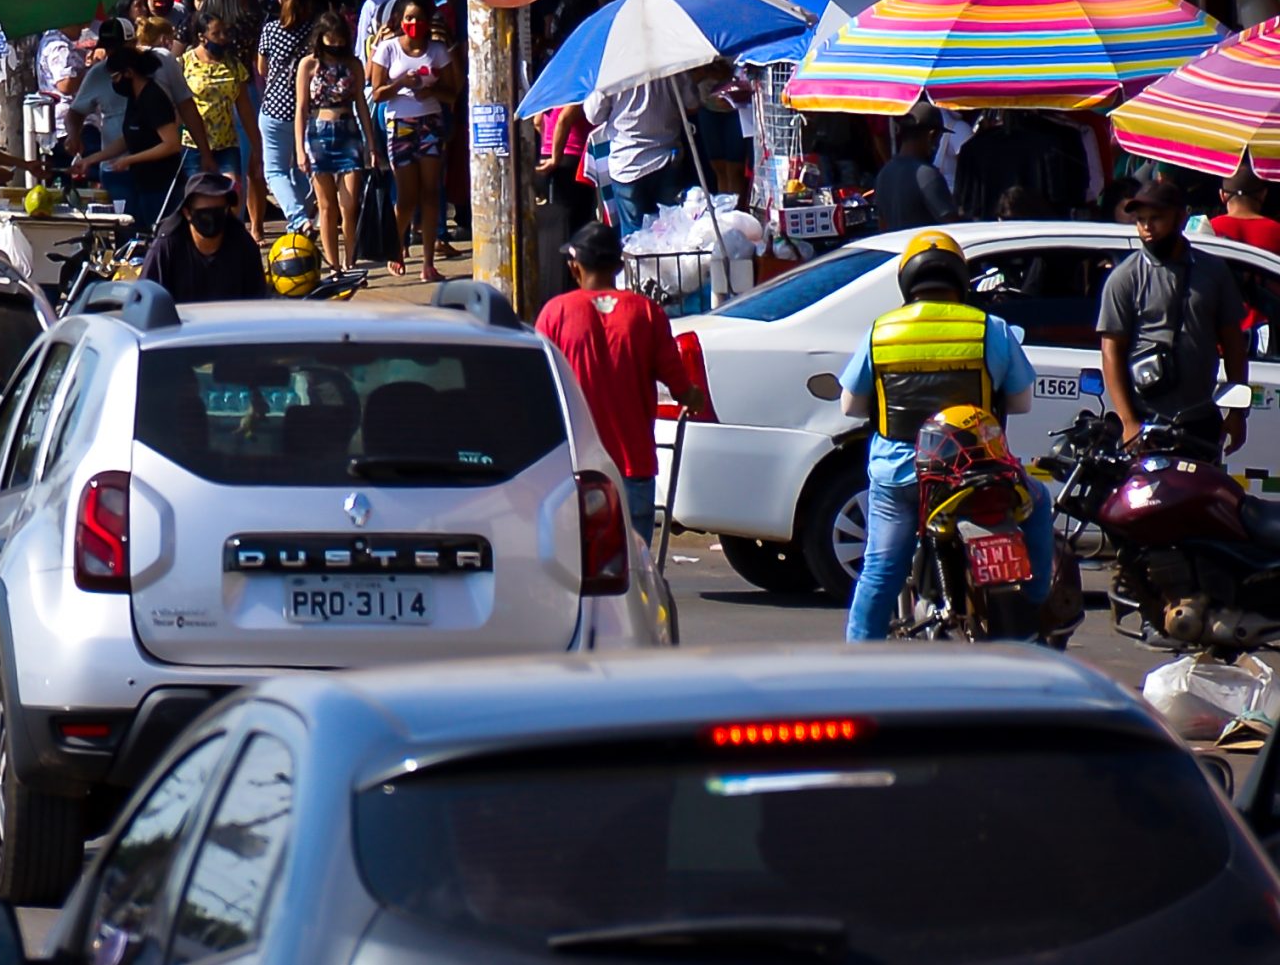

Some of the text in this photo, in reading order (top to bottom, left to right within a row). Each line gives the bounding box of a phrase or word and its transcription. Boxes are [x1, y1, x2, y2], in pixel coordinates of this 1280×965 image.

[1038, 379, 1077, 396] 1562
[238, 550, 482, 567] DUSTER
[976, 545, 1022, 565] NWL
